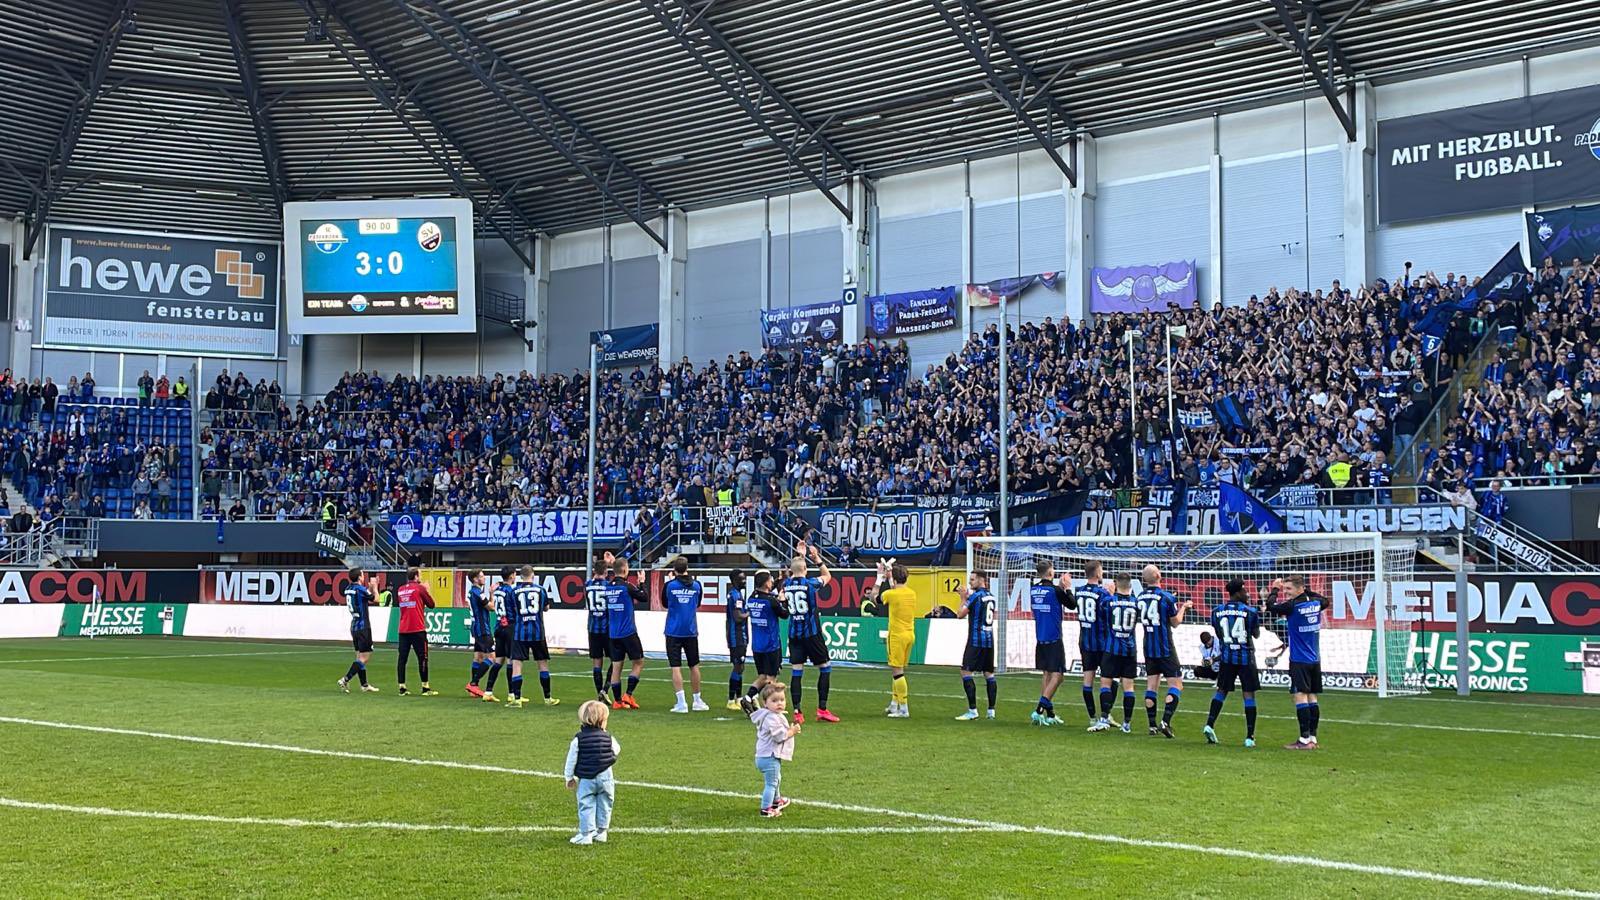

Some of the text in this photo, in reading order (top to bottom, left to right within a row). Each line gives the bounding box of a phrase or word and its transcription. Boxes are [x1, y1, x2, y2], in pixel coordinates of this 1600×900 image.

[1391, 125, 1562, 166] MIT HERZBLUT.
[1455, 151, 1563, 180] FUßBALL.
[76, 237, 172, 251] www.hewe-fensterbau.de
[60, 237, 212, 296] hewe
[147, 302, 264, 323] fensterbau
[793, 304, 841, 319] Kommando
[57, 327, 92, 336] FENSTER
[102, 328, 128, 338] TÜREN
[791, 321, 809, 335] 07
[290, 334, 300, 345] N
[604, 352, 616, 361] DIE
[421, 509, 652, 538] DAS HERZ DES VEREIN
[1484, 526, 1498, 541] PB
[1502, 536, 1518, 552] SC
[438, 576, 447, 588] 11
[944, 578, 961, 592] 12
[518, 591, 540, 615] 13
[587, 590, 607, 612] 15
[1077, 596, 1097, 623] 18
[80, 604, 146, 626] HESSE
[986, 600, 994, 626] 6
[1112, 606, 1137, 632] 10
[1137, 599, 1161, 626] 24
[79, 625, 144, 636] MECHATRONICS
[1220, 616, 1247, 644] 14
[1405, 631, 1530, 674] HESSE
[1403, 671, 1529, 692] MECHARONICS
